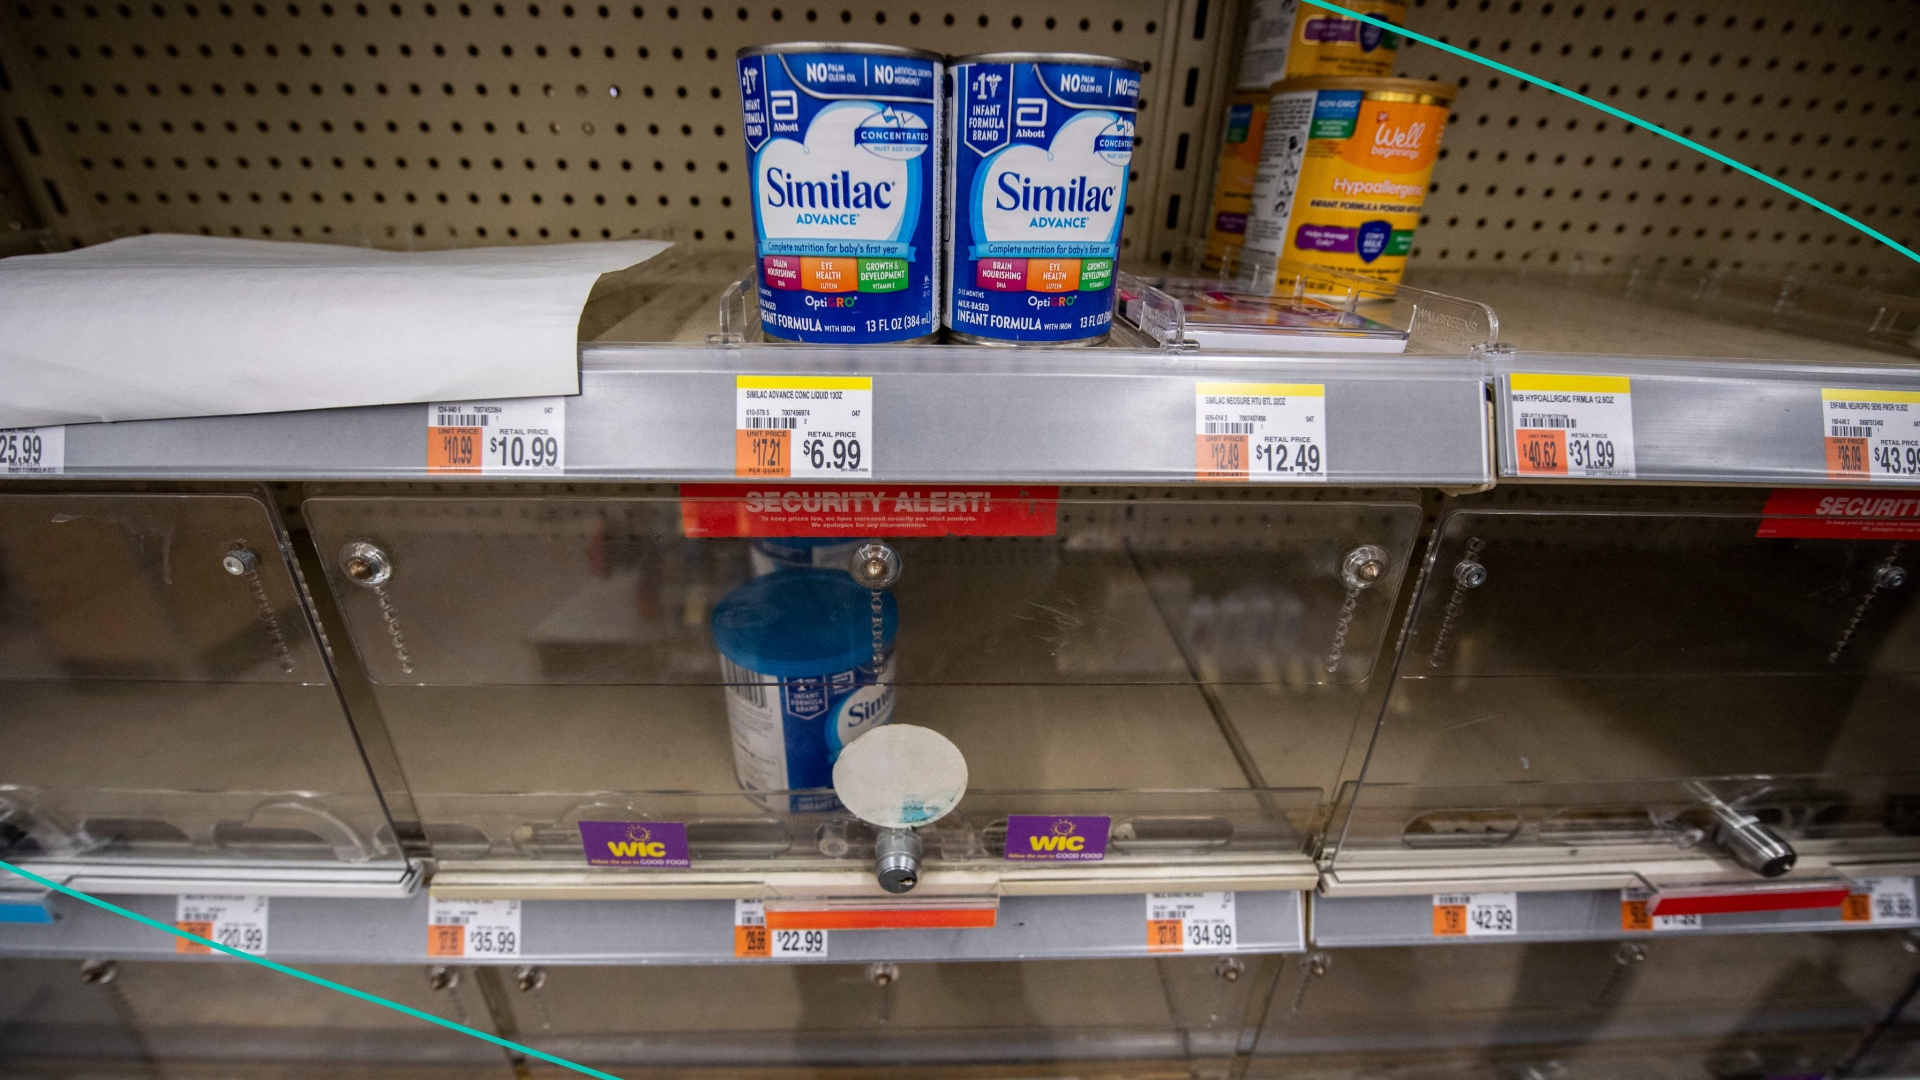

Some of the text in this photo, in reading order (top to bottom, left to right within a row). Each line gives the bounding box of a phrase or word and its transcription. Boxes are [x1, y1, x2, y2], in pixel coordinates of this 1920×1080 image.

[806, 63, 844, 82] NO PALM
[874, 64, 894, 84] NO
[972, 73, 988, 100] #1
[1060, 74, 1095, 92] NO PALM
[1116, 78, 1128, 96] NO
[972, 104, 1000, 116] INFANT
[774, 122, 799, 132] Abbott
[969, 116, 1004, 129] FORMULA
[861, 130, 929, 142] CONCENTRATED
[972, 130, 998, 142] BRAND
[1016, 129, 1045, 138] Abbott
[1375, 122, 1426, 148] Well
[766, 166, 893, 210] Similac
[996, 171, 1114, 213] Similac
[1310, 200, 1338, 208] INFANT
[796, 214, 857, 226] ADVANCE
[1029, 216, 1086, 228] ADVANCE
[768, 242, 898, 256] Complete nutrition for baby's first year
[988, 244, 1100, 255] Complete nutrition for baby's first
[773, 259, 788, 269] BRAIN
[820, 261, 833, 270] EYE
[866, 262, 894, 271] GROWTH
[992, 261, 1012, 270] BRAIN
[1050, 262, 1061, 270] EYE
[768, 268, 796, 279] NOURISHING
[816, 270, 841, 280] HEALTH
[860, 270, 905, 281] DEVELOPMENT
[982, 270, 1021, 280] NOURISHING
[1042, 272, 1067, 280] HEALTH
[1082, 269, 1112, 280] DEVELOPMENT
[804, 296, 855, 310] OptiGRO
[958, 300, 990, 312] MILK-BASED
[1028, 295, 1075, 310] OptiGRO
[778, 314, 822, 332] FORMULA
[840, 325, 856, 333] IRON
[866, 314, 920, 332] 13 FL OZ (384
[958, 310, 988, 327] INFANT
[990, 316, 1042, 330] FORMULA
[1080, 314, 1096, 328] 13 FL
[1416, 307, 1478, 334] WALGREENS
[746, 390, 828, 400] SIMILAC ADVANCE CONC LIQUID
[1205, 396, 1226, 405] SIMILAC
[1226, 397, 1250, 406] NEOSURE
[1251, 398, 1262, 406] RTU
[1526, 395, 1572, 403] HYPOALLRGNC
[444, 436, 472, 464] $10.99
[490, 436, 558, 467] $10.99
[752, 438, 780, 467] $17.21
[803, 439, 861, 470] $6.99
[1212, 443, 1239, 470] $12.49
[1523, 440, 1558, 468] $40.62
[1569, 440, 1615, 468] $31.99
[1256, 444, 1320, 472] $12.49
[746, 491, 991, 513] SECURITY ALERT!
[607, 841, 666, 858] WIC
[1030, 836, 1085, 852] WIC
[1472, 910, 1513, 930] $42.99
[470, 932, 516, 952] $35.99
[777, 930, 823, 952] $22.99
[1188, 924, 1232, 946] $34.99
